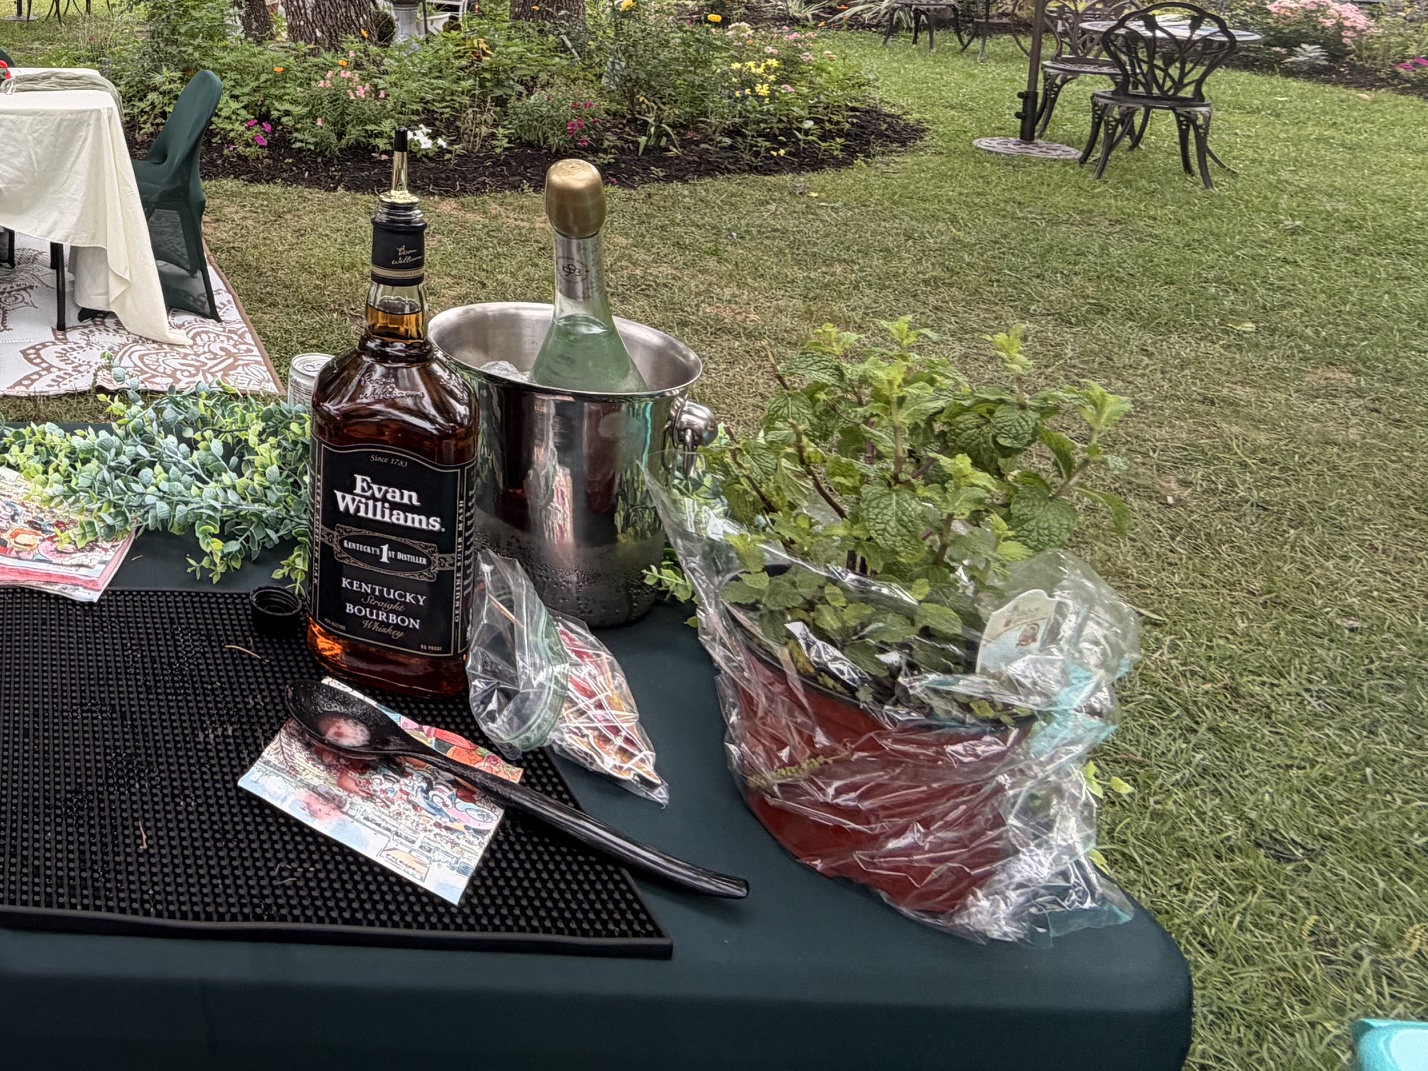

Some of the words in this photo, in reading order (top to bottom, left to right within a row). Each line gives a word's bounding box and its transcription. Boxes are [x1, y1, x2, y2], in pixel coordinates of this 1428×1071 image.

[370, 454, 389, 464] Since
[390, 458, 408, 468] 1783
[353, 473, 421, 506] Evan
[457, 500, 465, 531] MASH
[343, 539, 380, 556] KENTUCKY'S
[397, 551, 427, 565] DISTILLER
[341, 577, 427, 606] KENTUCKY
[361, 594, 406, 613] Straight
[454, 573, 462, 623] GENUINE
[345, 602, 420, 630] BOURBON
[362, 618, 406, 640] Whiskey
